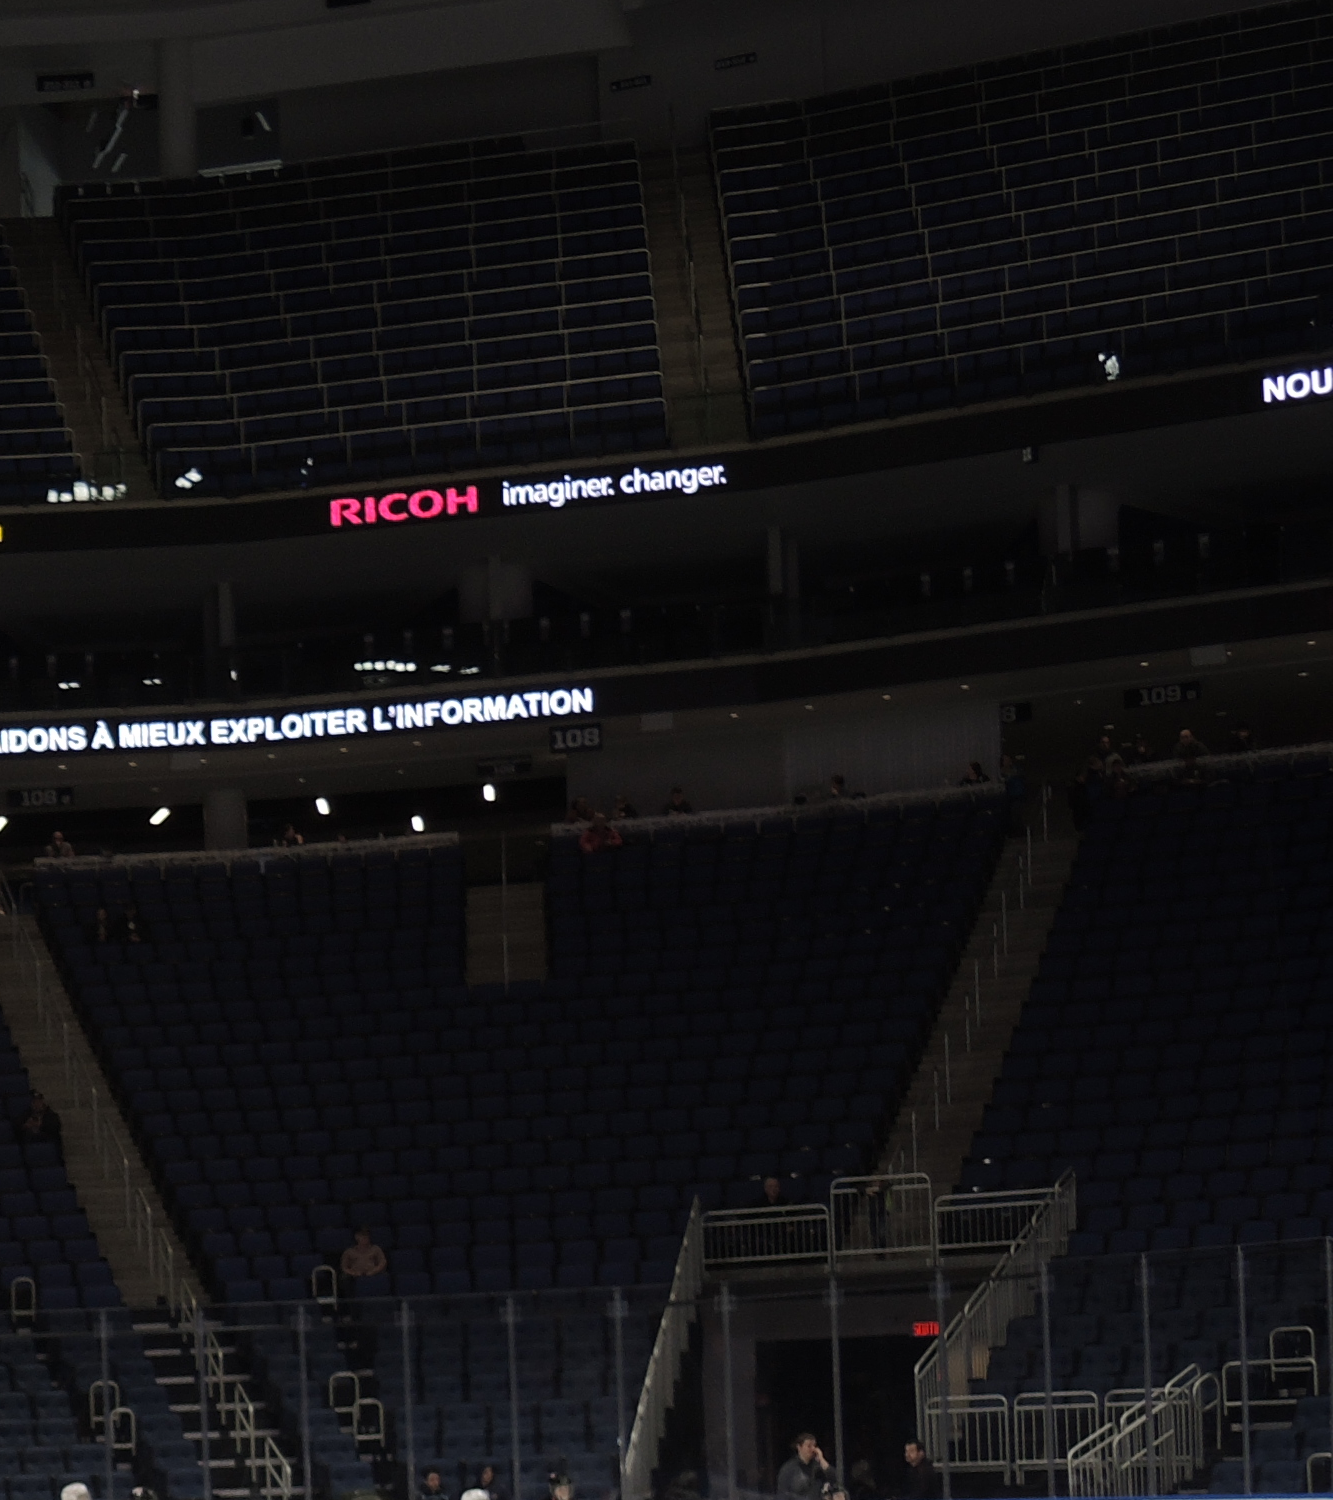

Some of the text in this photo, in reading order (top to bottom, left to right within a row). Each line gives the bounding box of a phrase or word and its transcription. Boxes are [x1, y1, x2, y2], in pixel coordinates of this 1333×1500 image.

[330, 485, 480, 526] RICOH
[503, 463, 729, 509] imaginer. changer.
[91, 720, 114, 749] À
[119, 721, 206, 748] MIEUX
[210, 708, 366, 744] EXPLOITER
[373, 688, 593, 731] L'INFORMATION
